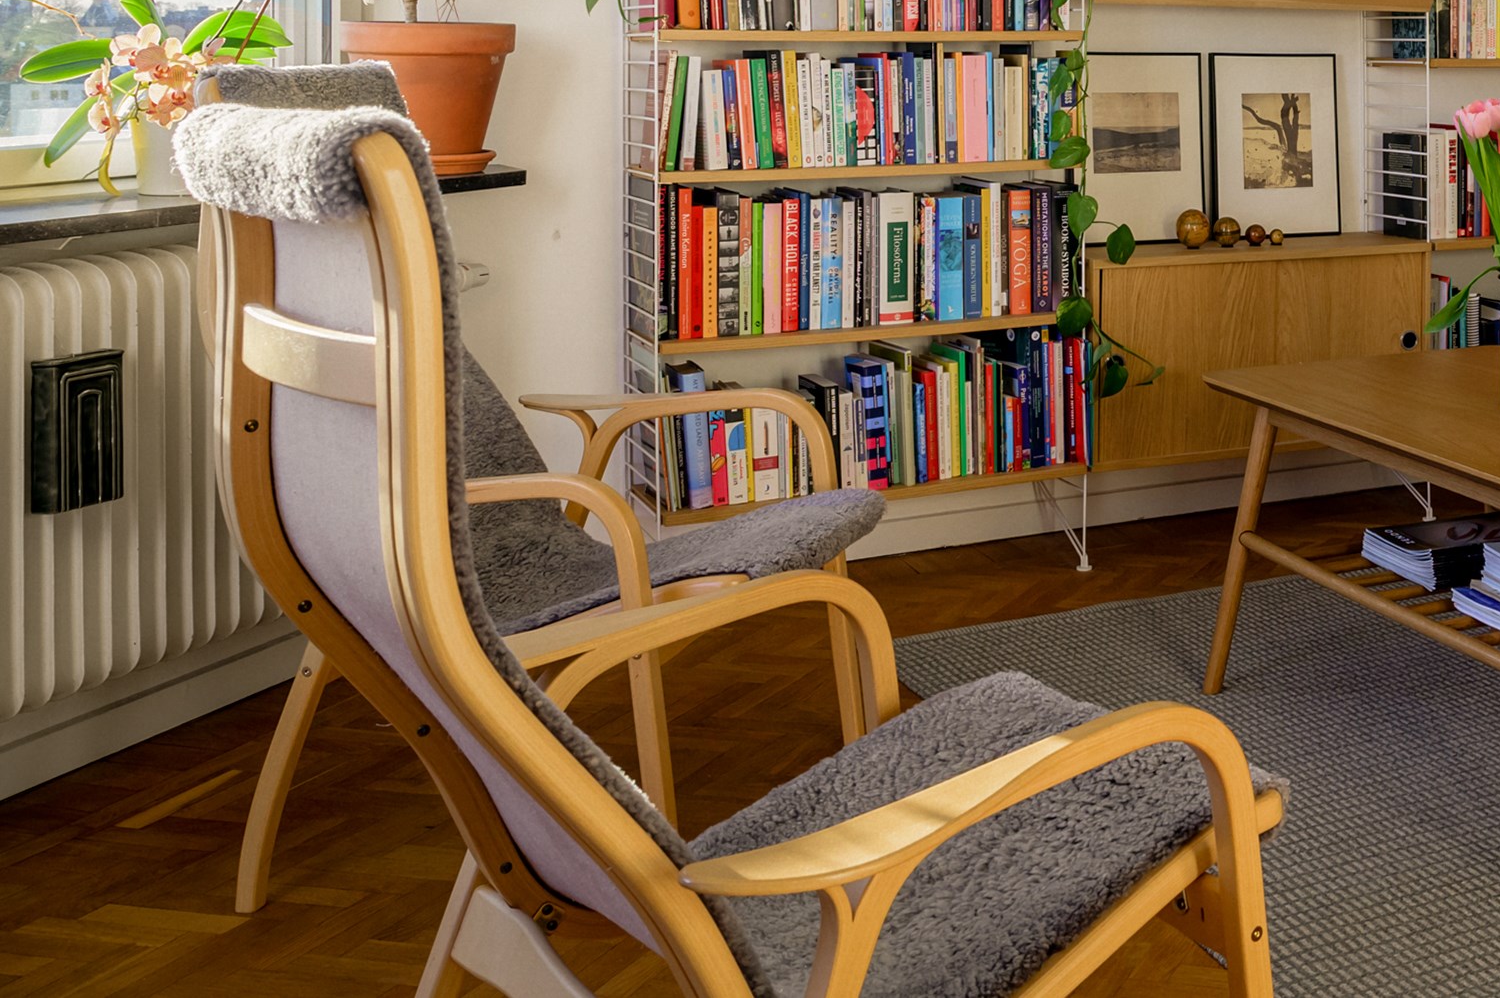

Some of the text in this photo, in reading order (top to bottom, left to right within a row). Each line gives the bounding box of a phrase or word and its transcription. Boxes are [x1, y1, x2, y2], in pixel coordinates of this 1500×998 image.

[1448, 138, 1456, 184] BERLIN
[682, 214, 690, 269] Maira Kalman
[786, 203, 798, 274] BLACK HOLE
[830, 213, 838, 260] REALITY+
[1042, 242, 1048, 254] ON
[1060, 214, 1070, 244] BOOK
[671, 252, 676, 260] BY
[892, 227, 903, 284] Filosoferna
[1012, 235, 1027, 289] YOGA
[1062, 251, 1070, 298] SYMBOLS
[812, 272, 820, 294] PLANET?
[693, 378, 698, 390] MY
[1384, 529, 1416, 545] ZENDO
